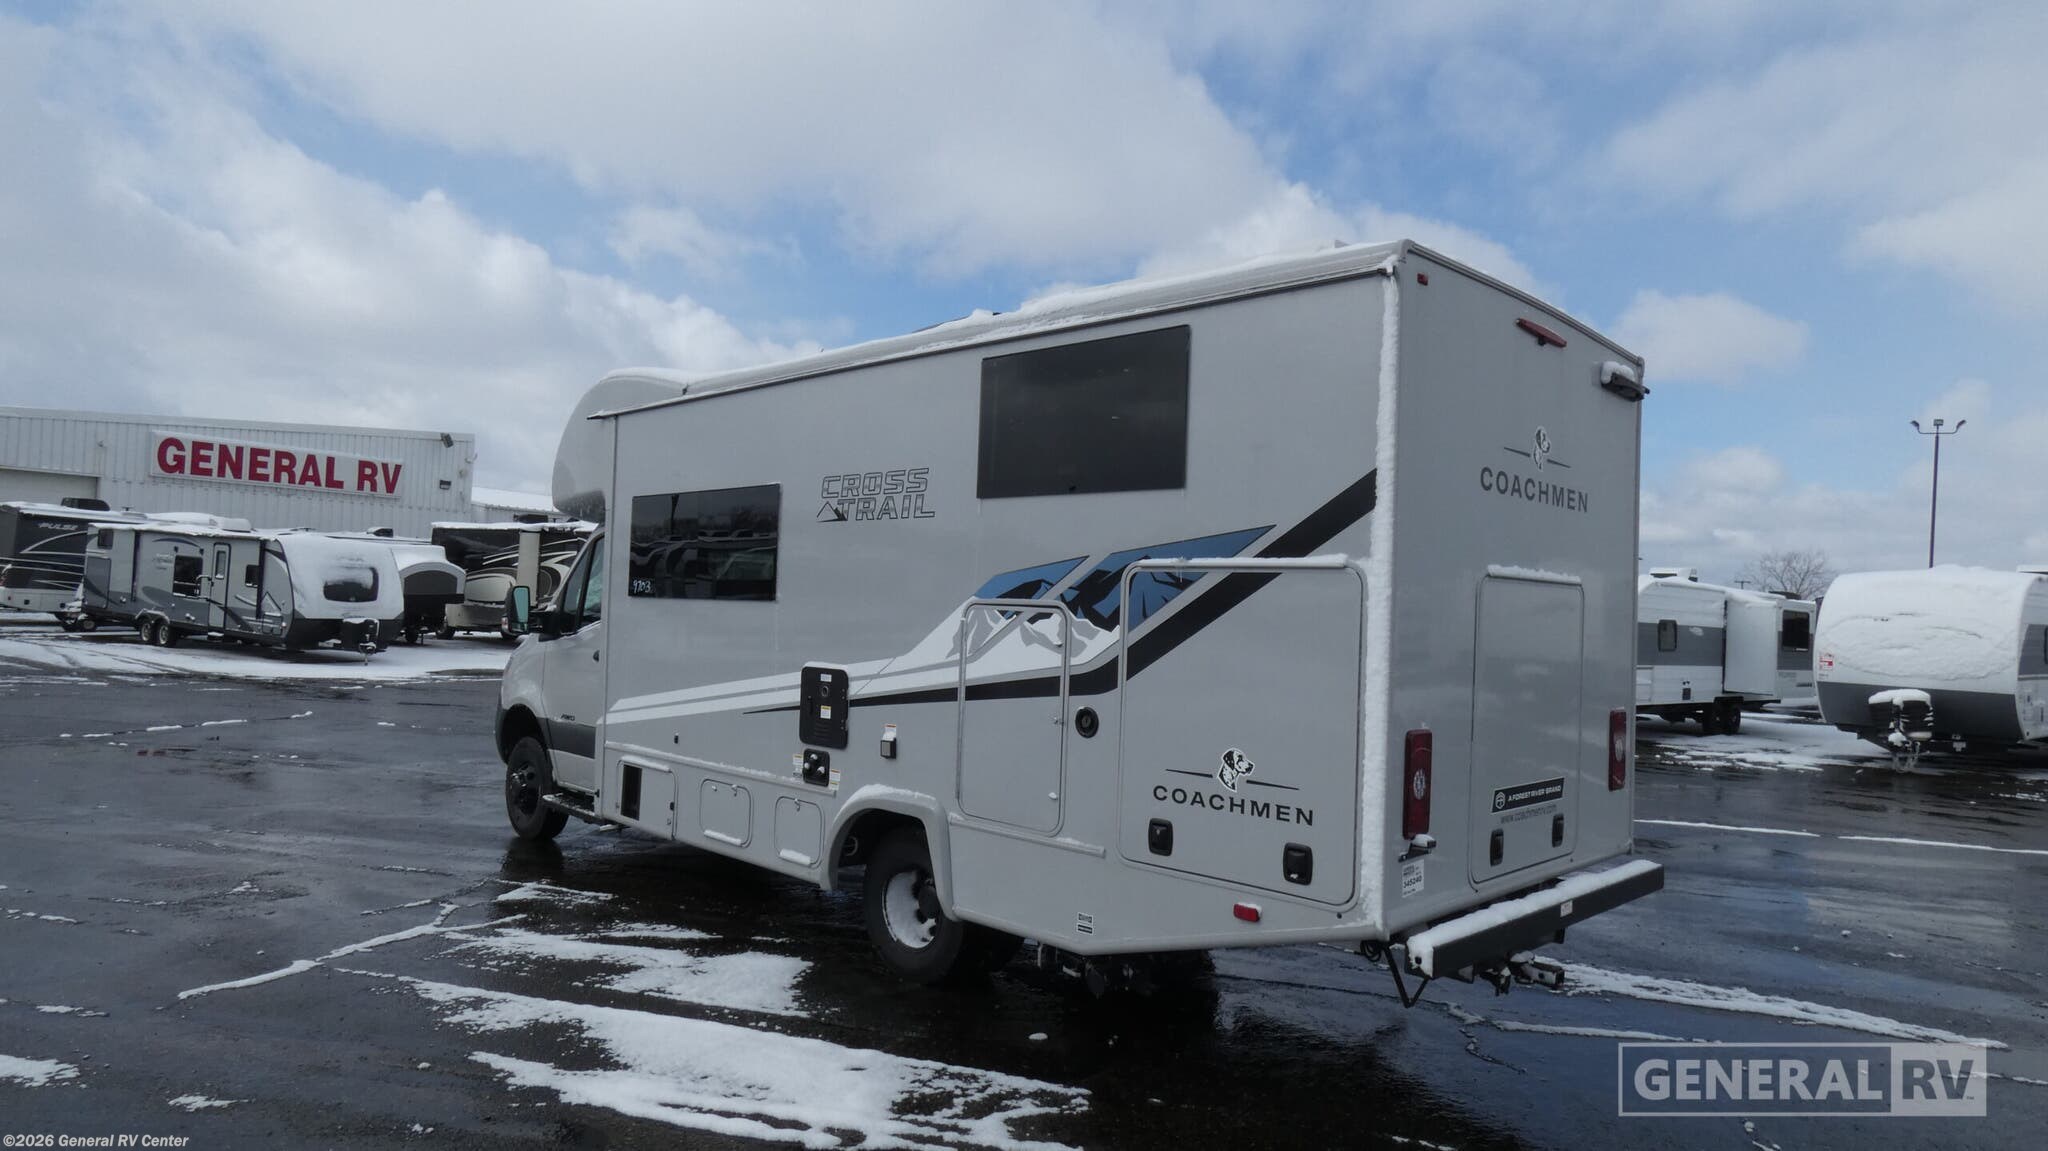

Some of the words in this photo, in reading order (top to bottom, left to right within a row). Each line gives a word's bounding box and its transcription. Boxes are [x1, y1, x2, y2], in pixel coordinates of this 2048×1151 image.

[157, 437, 344, 489] GENERAL
[356, 460, 402, 494] RV
[821, 468, 930, 499] CROSS
[837, 494, 936, 521] TRAIL
[1481, 467, 1588, 513] COACHMEN
[1153, 785, 1314, 826] COACHMEN
